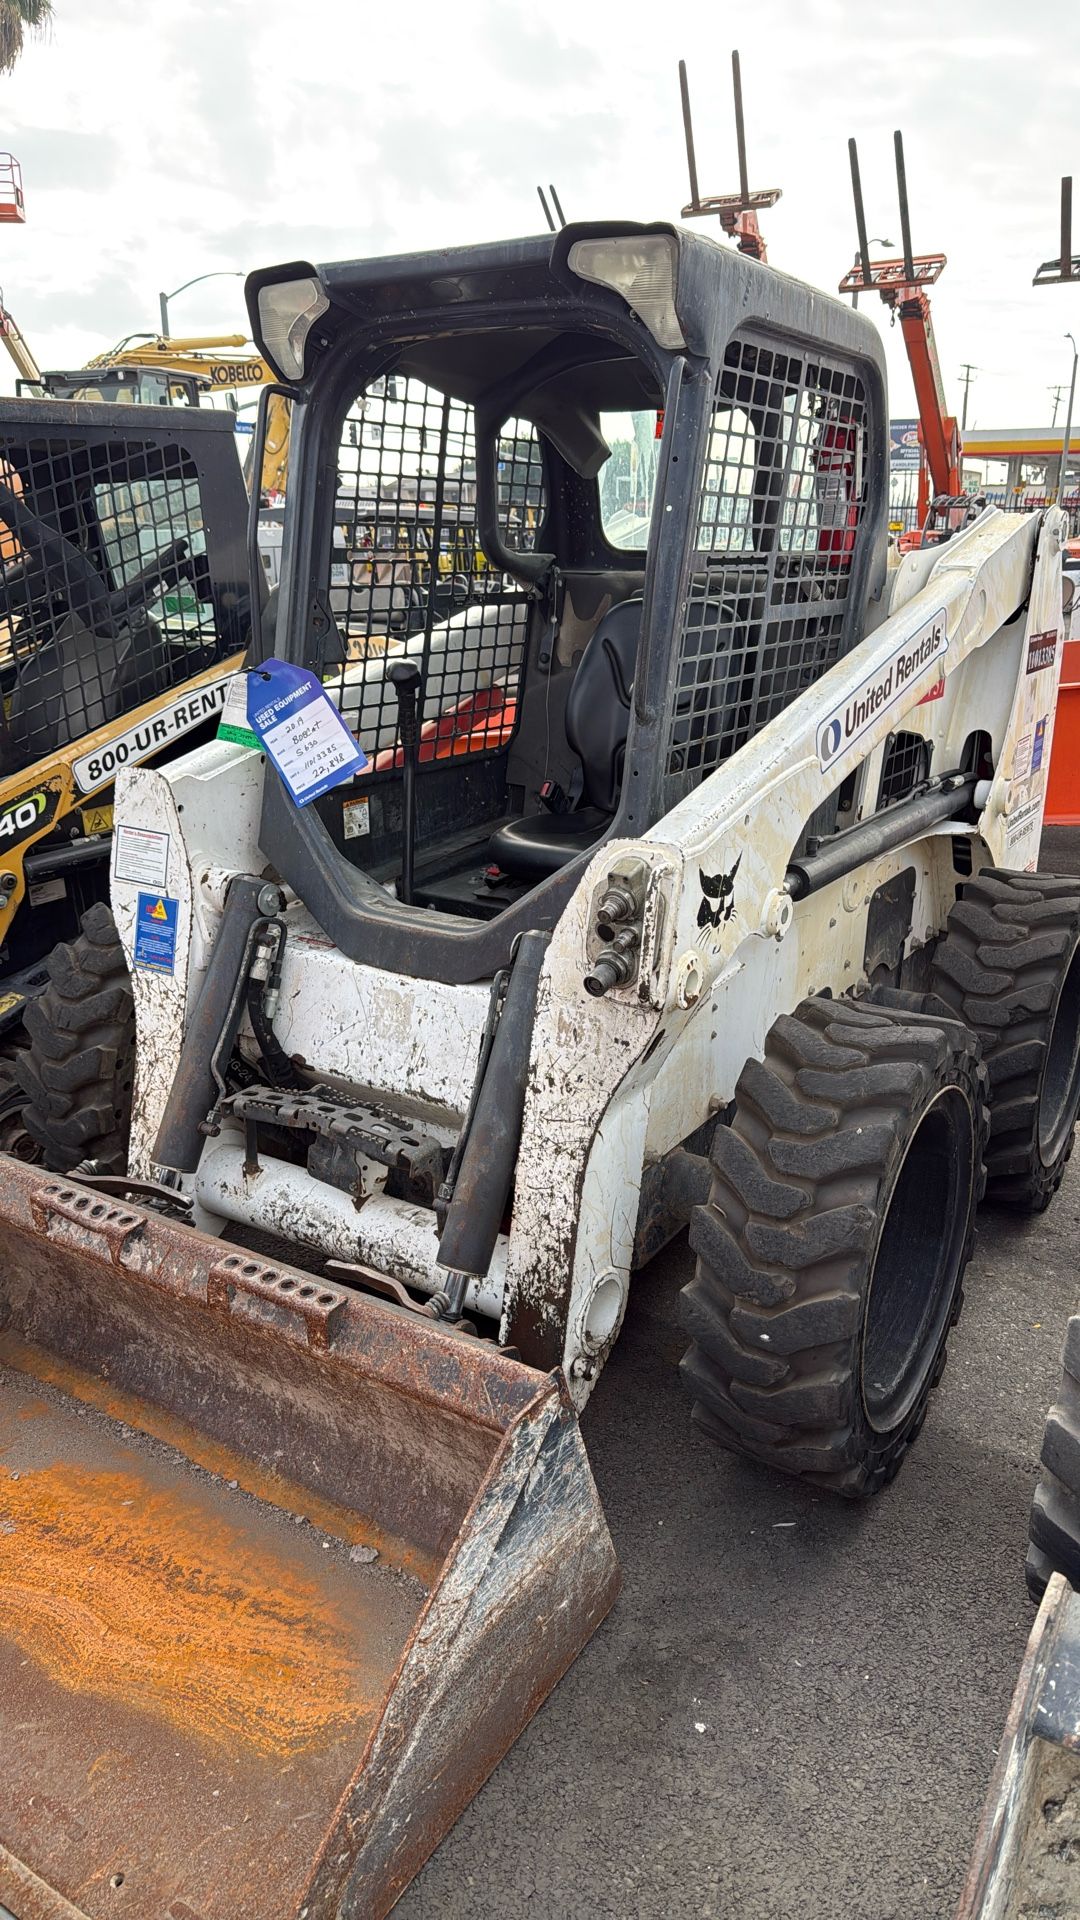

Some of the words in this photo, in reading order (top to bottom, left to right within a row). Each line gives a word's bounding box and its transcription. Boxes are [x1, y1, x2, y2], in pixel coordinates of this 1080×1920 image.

[210, 364, 263, 384] KOBELCO
[844, 667, 893, 738] United
[895, 624, 941, 688] Rentals
[255, 708, 275, 724] USED
[273, 681, 312, 711] EQUIPMENT
[259, 714, 278, 730] SALE
